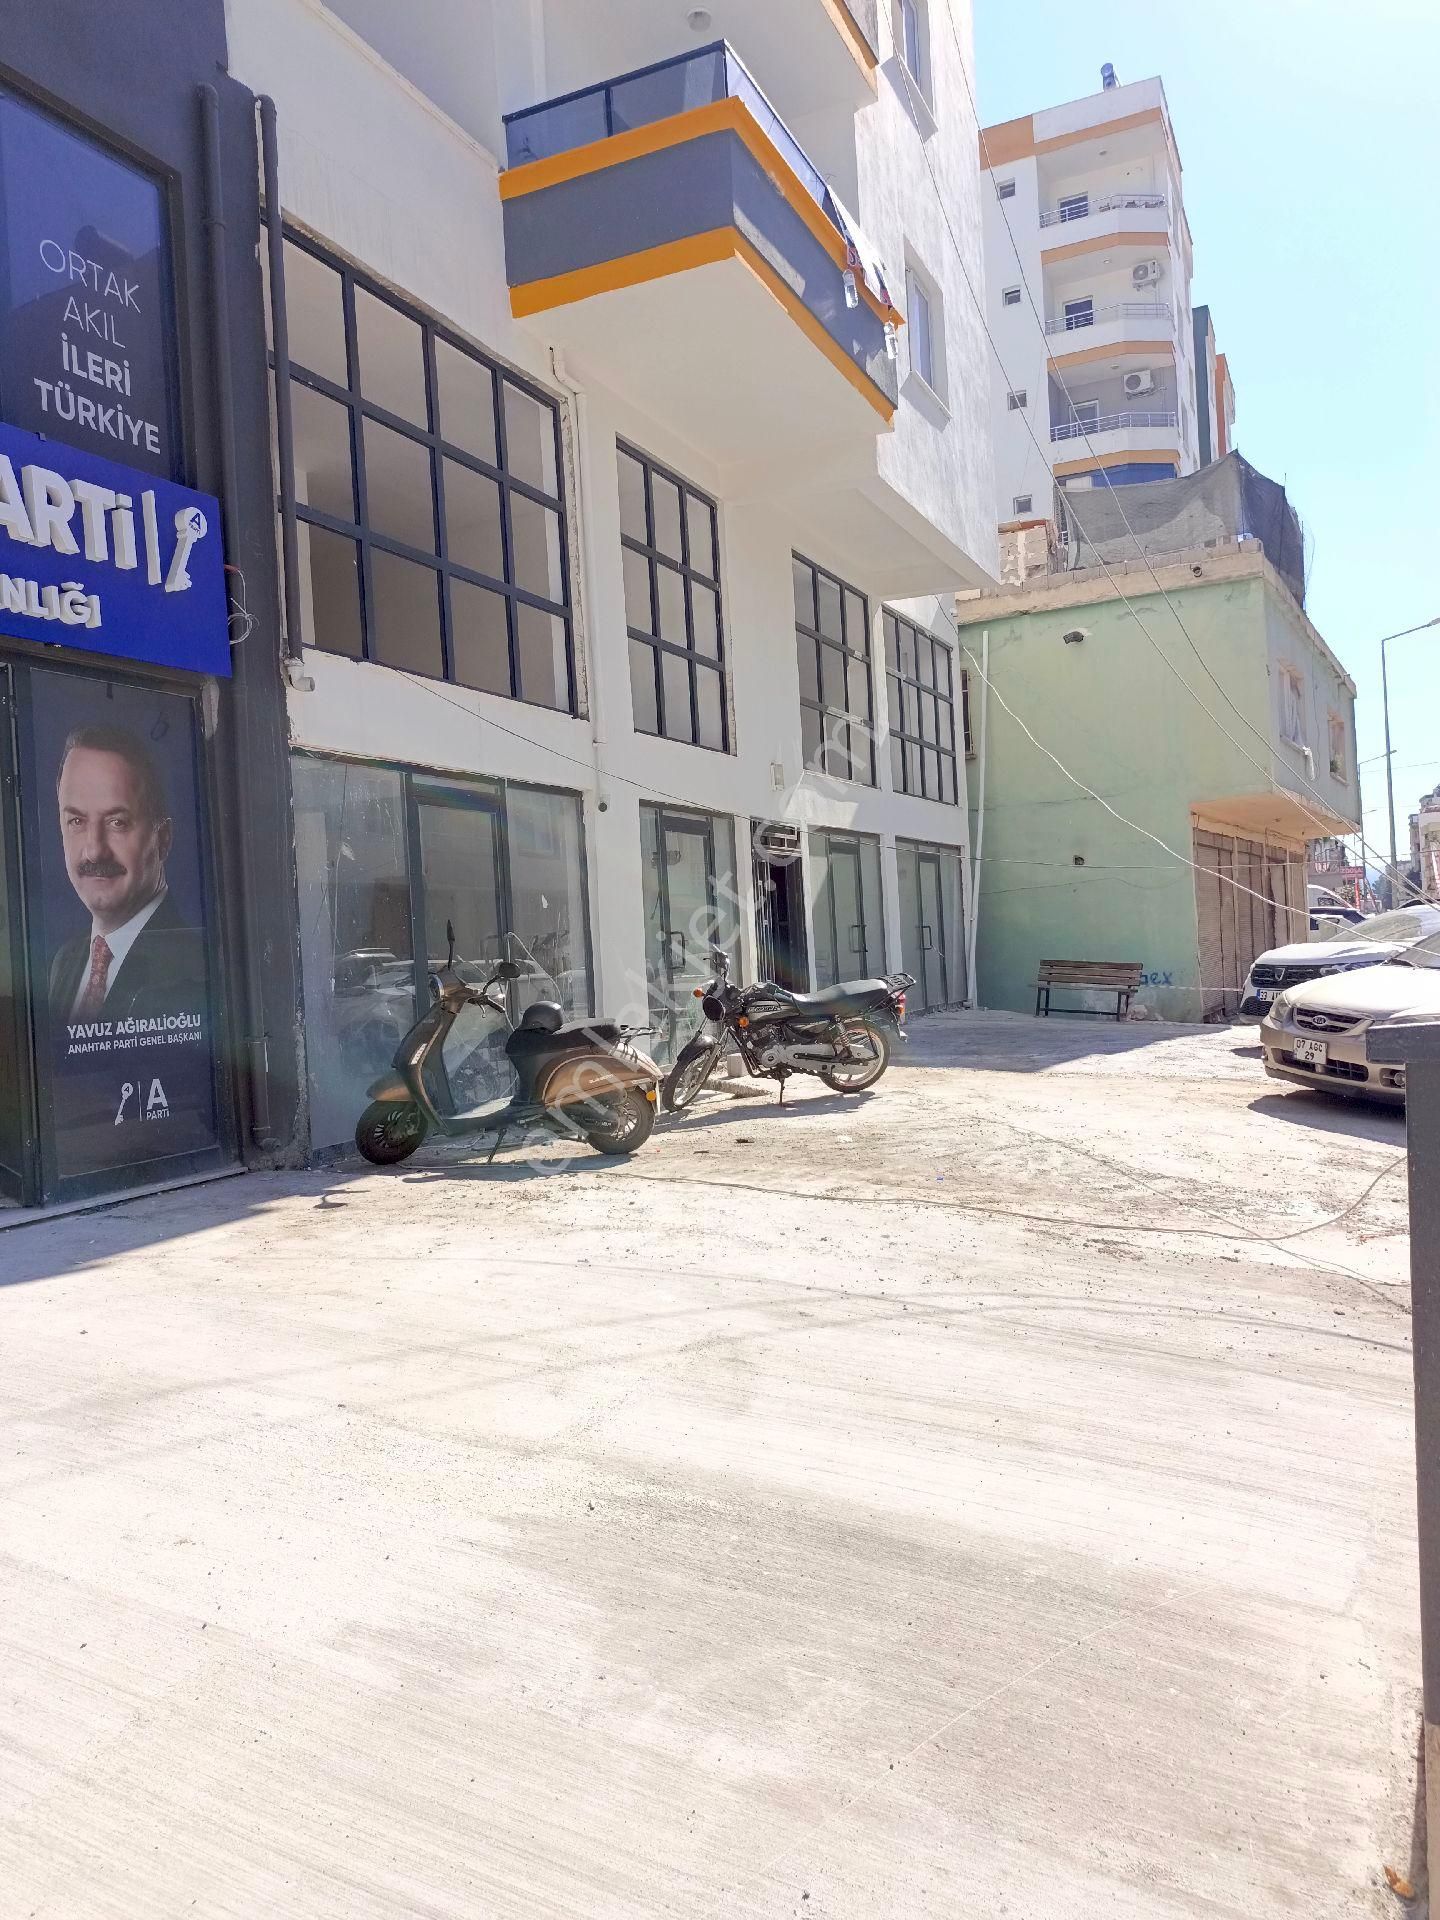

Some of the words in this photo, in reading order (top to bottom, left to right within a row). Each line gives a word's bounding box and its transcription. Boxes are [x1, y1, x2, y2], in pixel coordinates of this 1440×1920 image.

[40, 239, 141, 313] ORTAK
[63, 296, 126, 349] AKIL
[61, 332, 131, 397] İLERİ
[33, 377, 161, 455] TÜRKİYE
[67, 1022, 113, 1039] YAVUZ
[116, 1012, 201, 1035] AĞIRALİOĞLU
[68, 1040, 112, 1055] ANAHTAR
[114, 1035, 138, 1050] PARTİ
[140, 1035, 166, 1047] GENEL
[168, 1031, 202, 1045] BAŞKANI
[1304, 1051, 1315, 1060] 29
[1309, 1041, 1323, 1053] AGC
[146, 1078, 168, 1110] A
